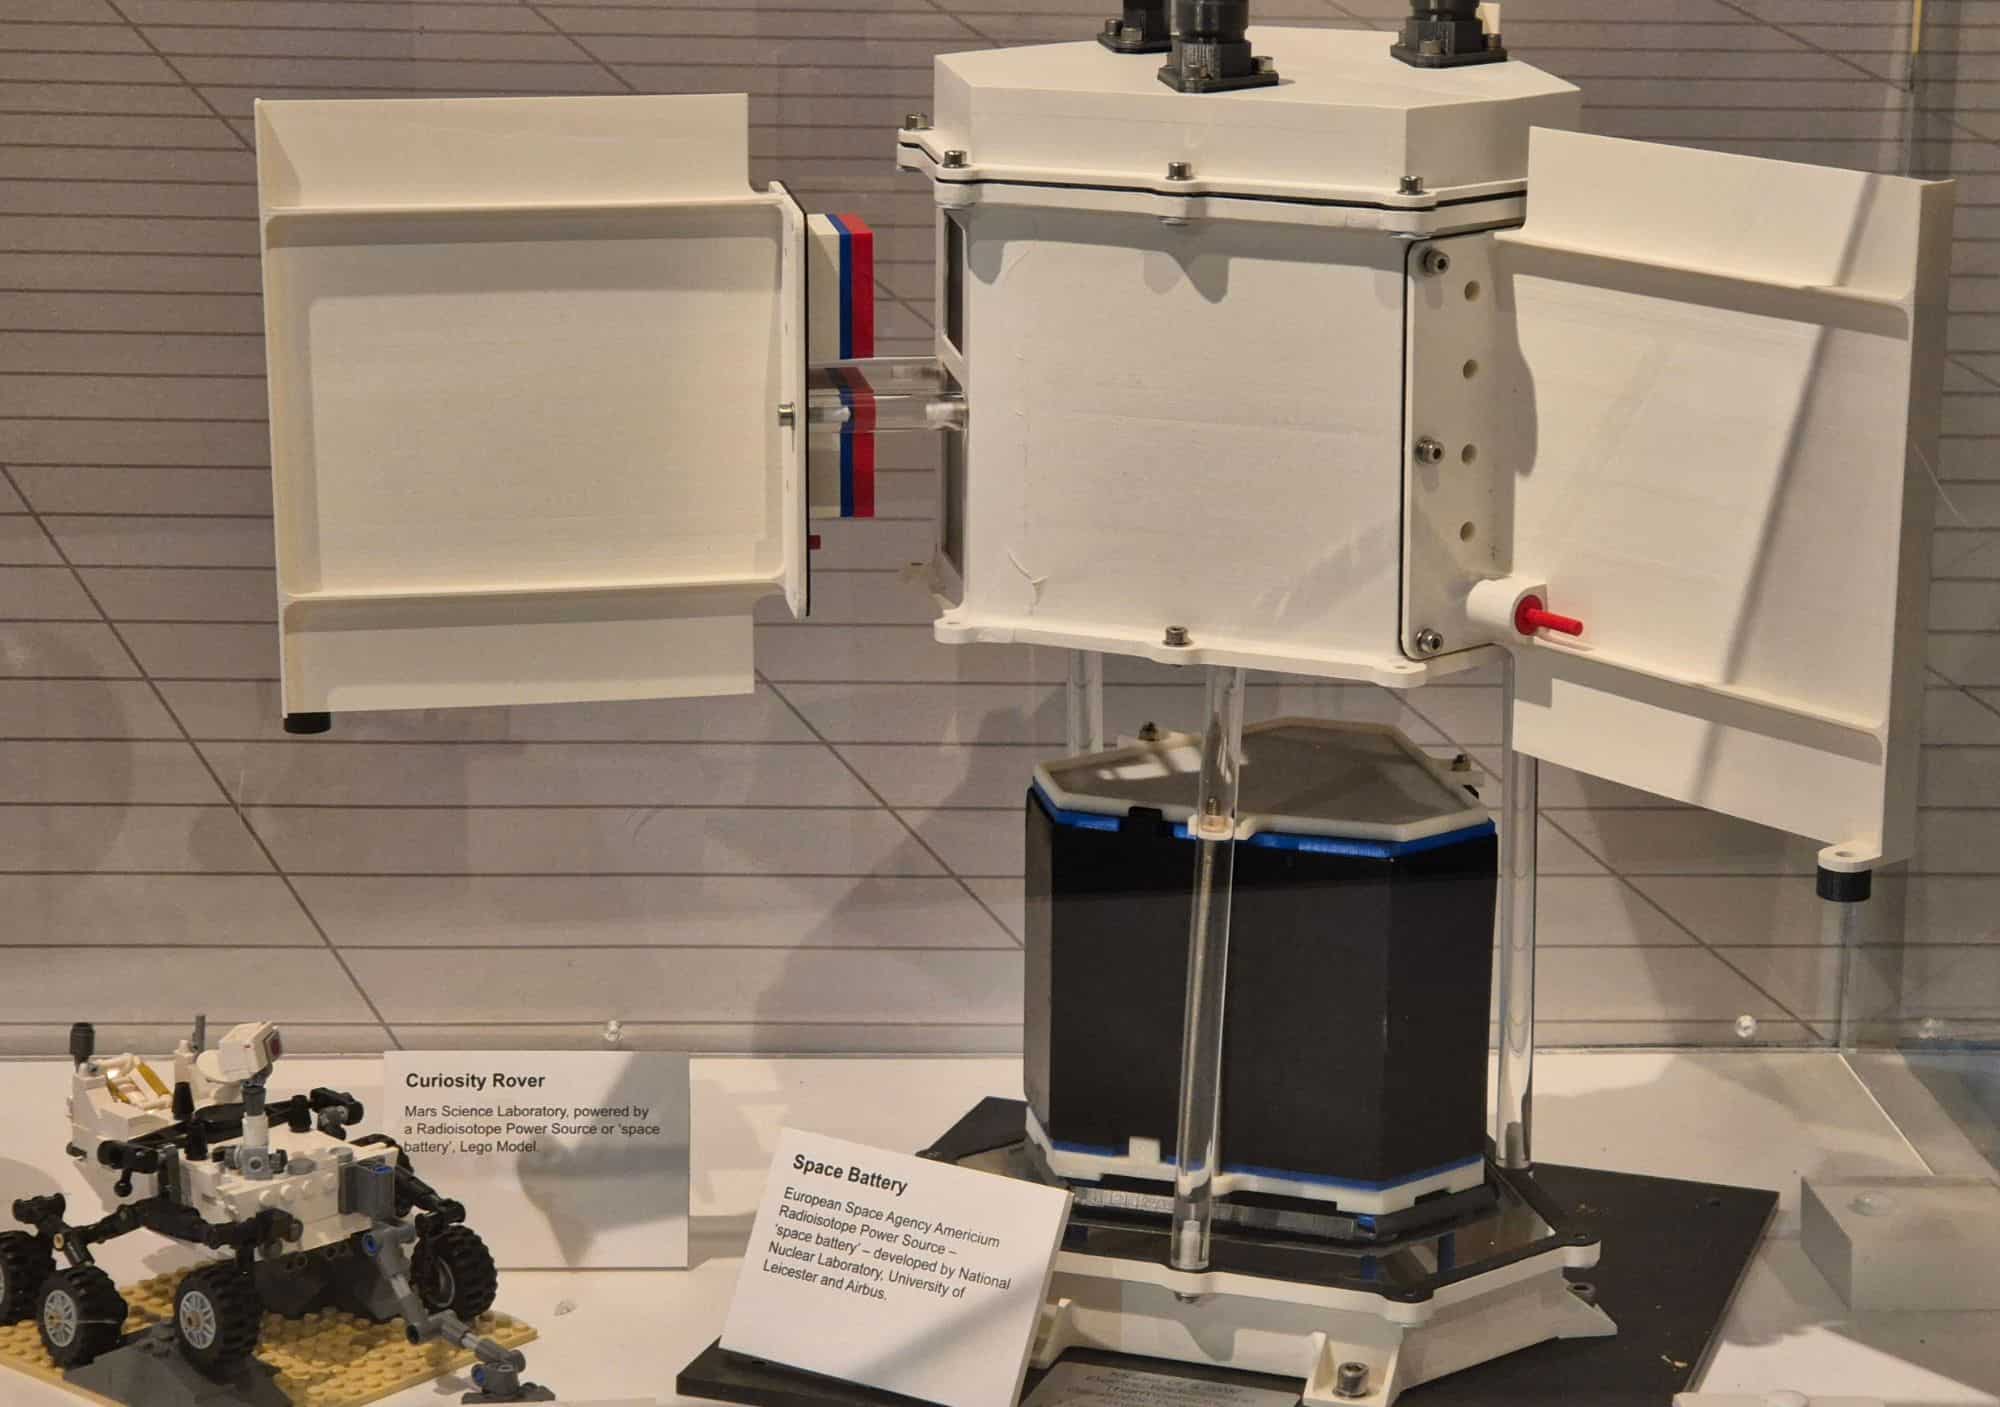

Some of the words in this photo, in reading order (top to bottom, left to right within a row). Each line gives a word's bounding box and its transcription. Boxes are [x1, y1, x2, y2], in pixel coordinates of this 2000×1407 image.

[406, 1073, 487, 1091] Curiosity
[493, 1073, 545, 1088] Rover
[404, 1125, 412, 1134] a
[417, 1122, 501, 1136] Radioisotope
[506, 1122, 547, 1134] Power
[551, 1122, 597, 1135] Source
[601, 1125, 615, 1135] or
[405, 1105, 437, 1117] Mars
[441, 1105, 493, 1117] Science
[497, 1105, 569, 1119] Laboratory,
[574, 1105, 630, 1119] powered
[633, 1104, 650, 1120] by
[460, 1141, 493, 1154] Lego
[793, 1153, 843, 1178] Space
[848, 1166, 908, 1196] Battery
[779, 1204, 857, 1233] Radioisotope
[859, 1224, 899, 1244] Power
[902, 1233, 945, 1255] Source
[784, 1186, 842, 1211] European
[845, 1201, 884, 1220] Space
[886, 1211, 932, 1234] Agency
[934, 1222, 1000, 1248] Americium
[763, 1258, 819, 1282] Leicester
[820, 1275, 844, 1289] and
[845, 1279, 888, 1301] Airbus.
[768, 1241, 815, 1262] Nuclear
[817, 1253, 884, 1281] Laboratory,
[888, 1270, 950, 1298] University
[952, 1286, 966, 1299] of
[873, 1248, 938, 1272] developed
[940, 1262, 956, 1278] by
[958, 1267, 1012, 1290] National
